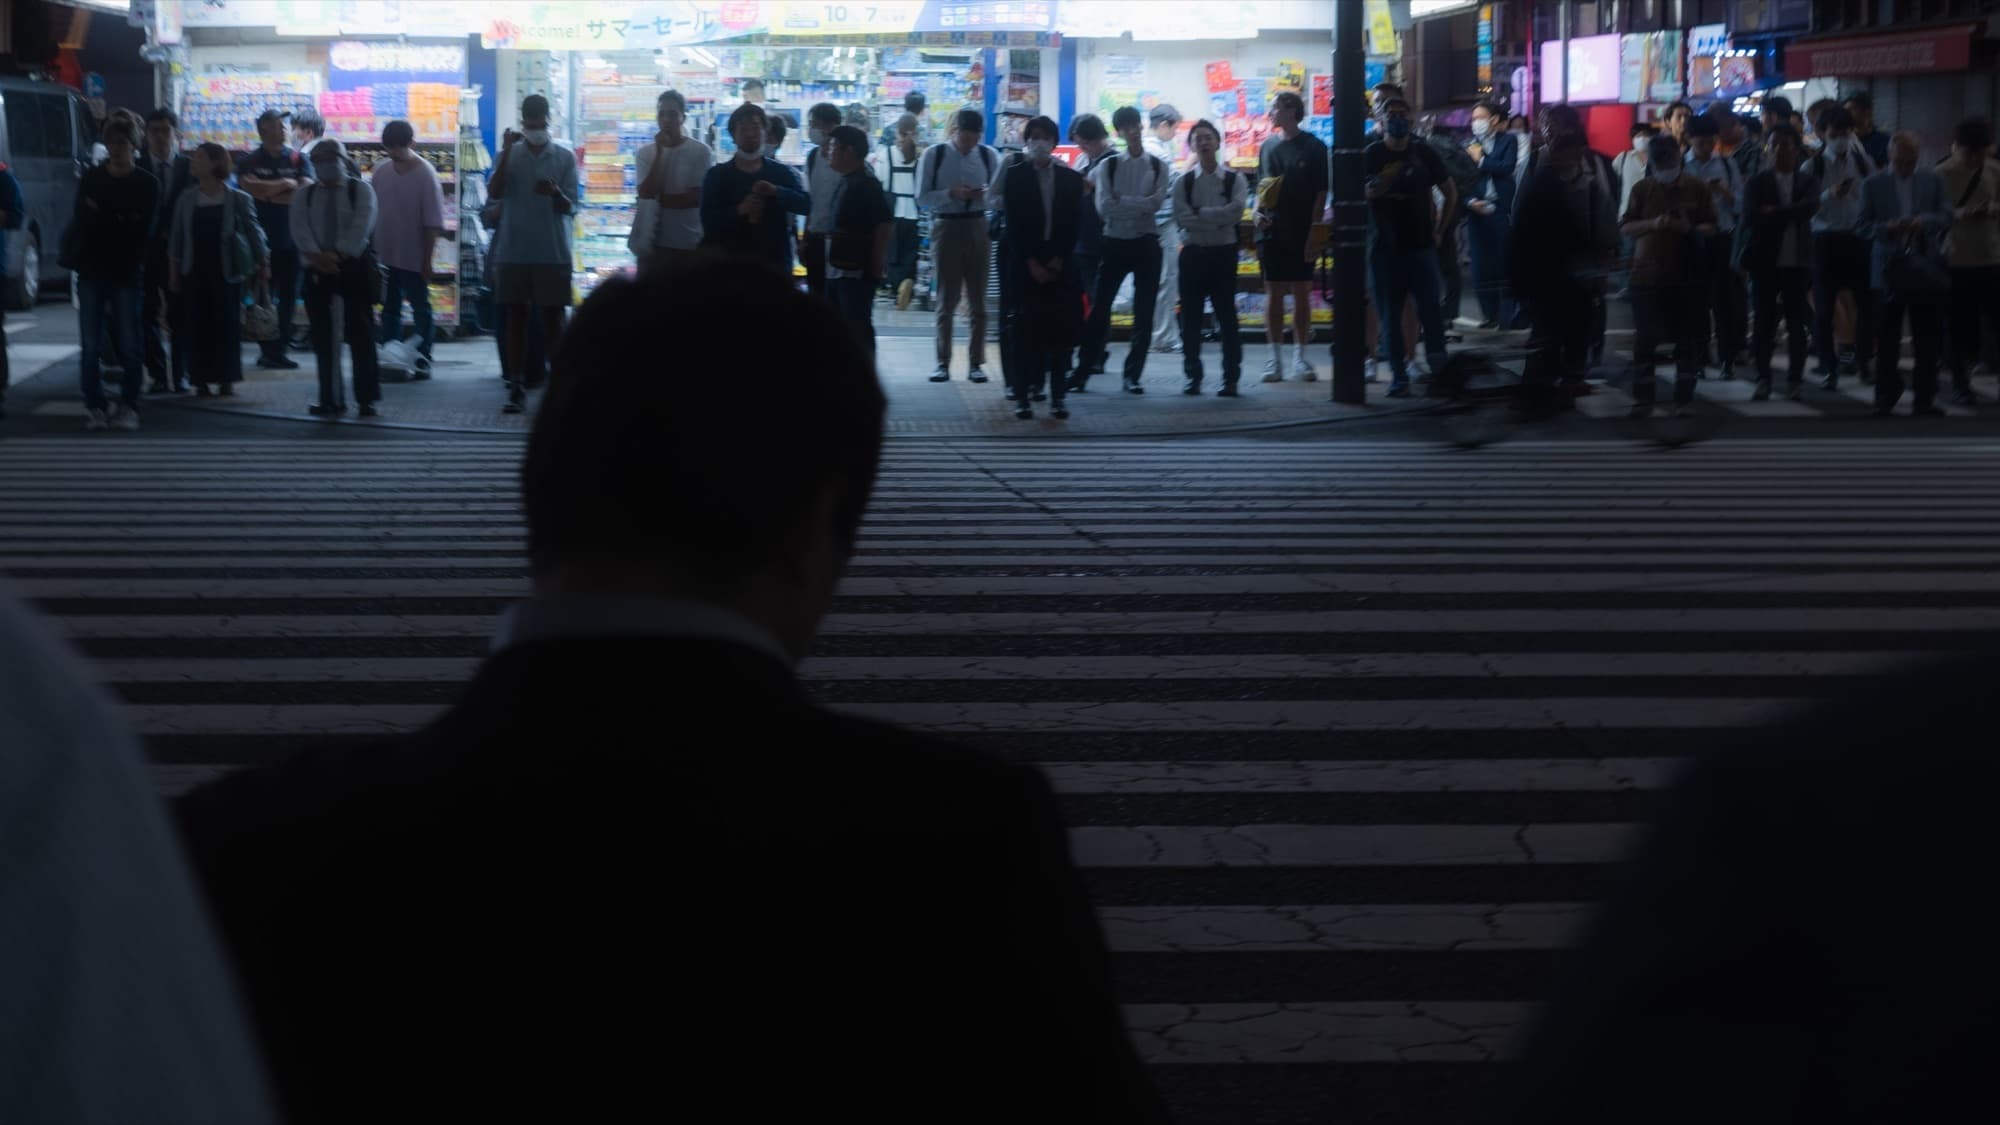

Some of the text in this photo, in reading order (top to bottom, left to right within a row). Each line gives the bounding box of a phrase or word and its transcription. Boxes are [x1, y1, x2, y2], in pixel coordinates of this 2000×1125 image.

[493, 18, 581, 38] Welcome!
[586, 11, 716, 39] サマーセール
